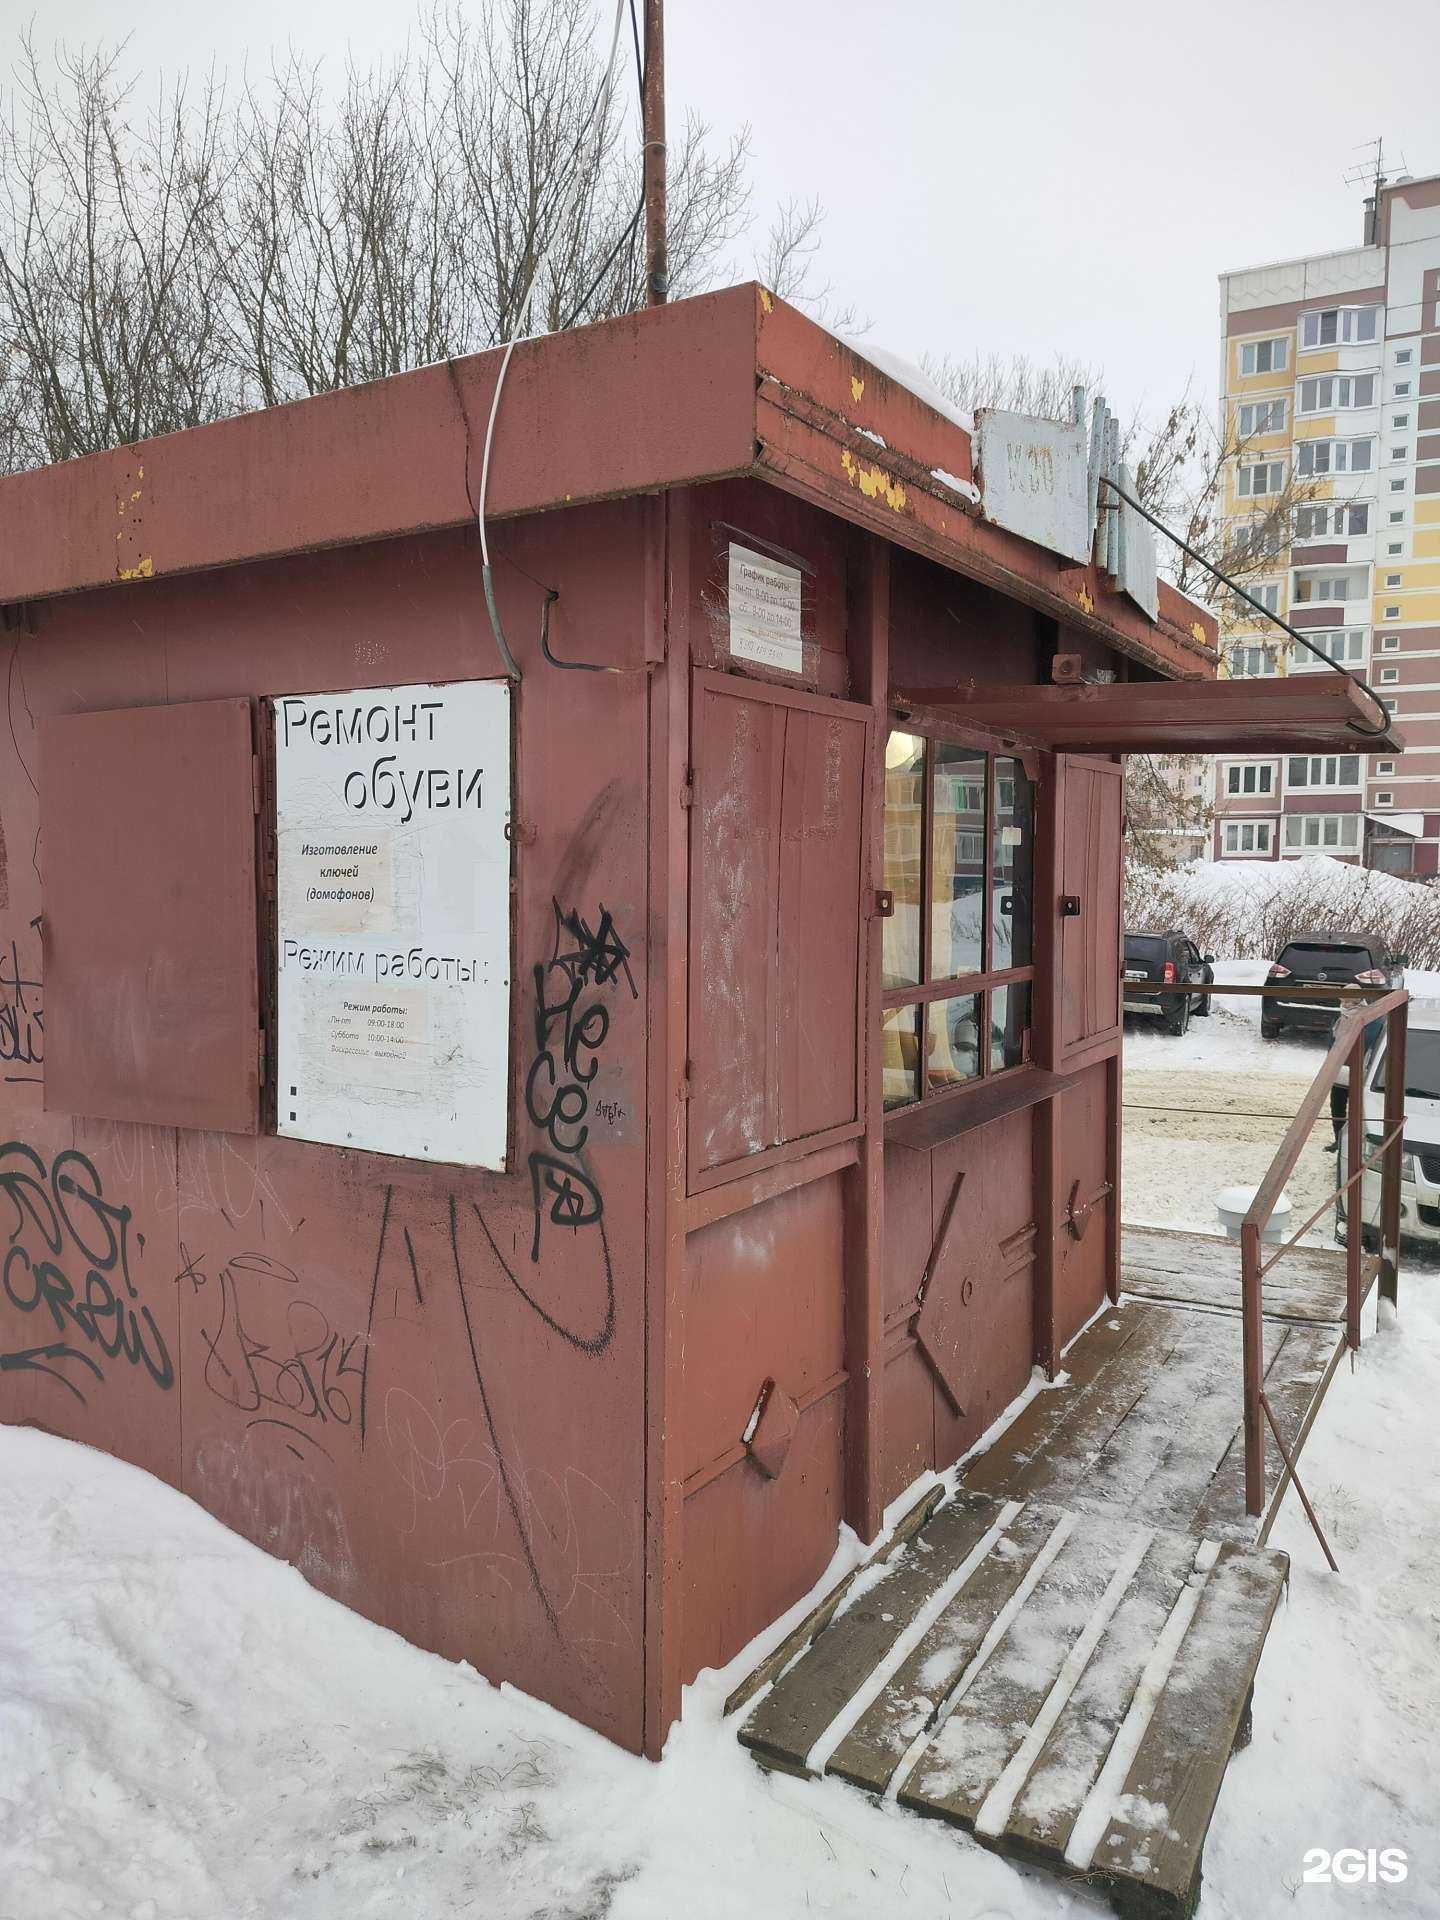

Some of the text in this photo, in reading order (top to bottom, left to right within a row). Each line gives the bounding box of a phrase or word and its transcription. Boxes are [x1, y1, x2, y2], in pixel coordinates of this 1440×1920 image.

[283, 700, 444, 748] Ремонт
[344, 755, 484, 824] обуви
[301, 844, 378, 856] Изготовление
[320, 864, 359, 878] ключей
[306, 887, 375, 903] (домофонов)
[283, 940, 365, 974] Режим
[343, 1001, 408, 1015] Режим работы:
